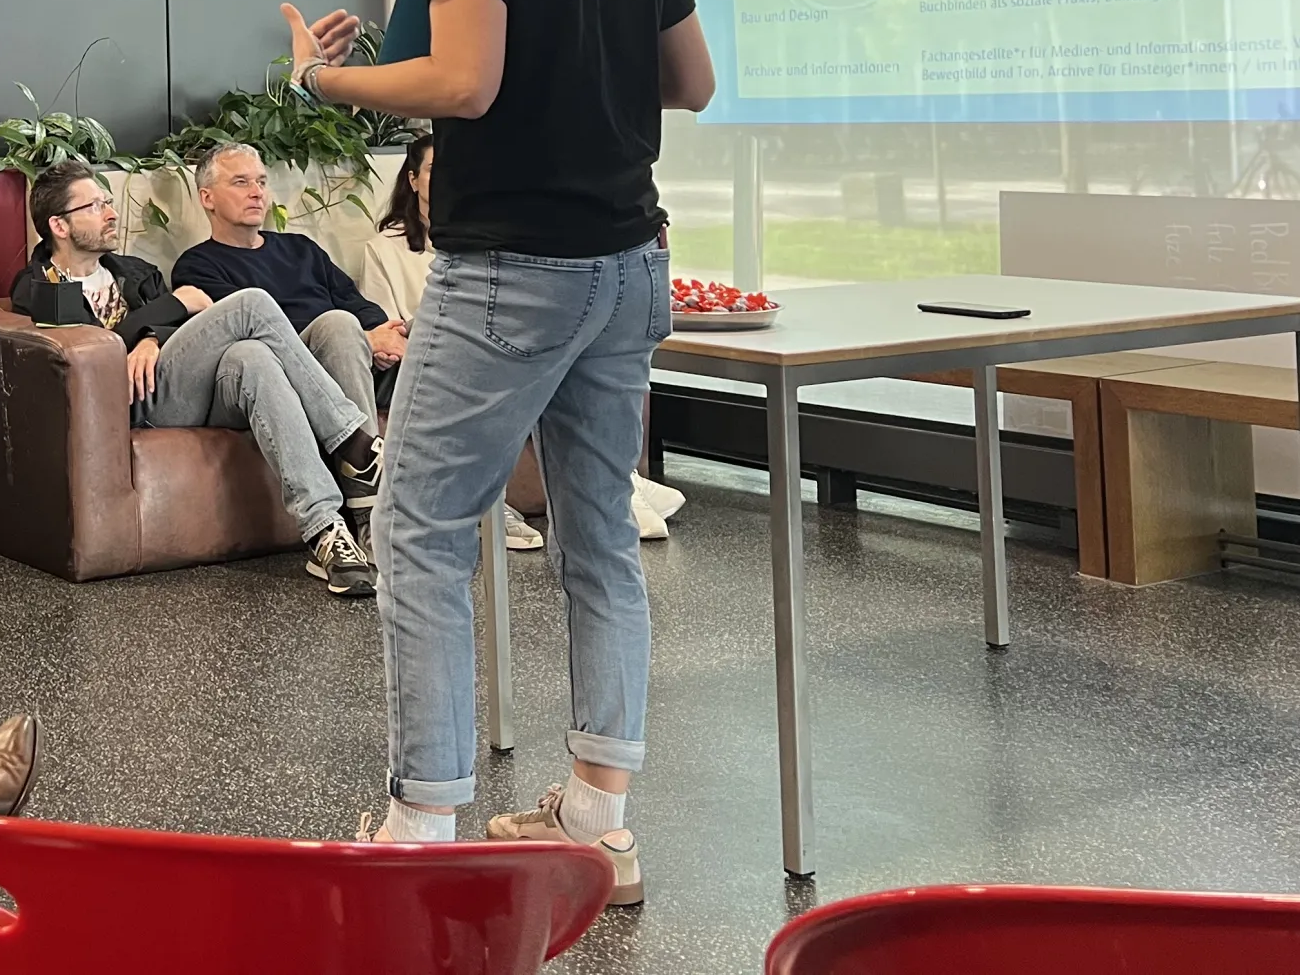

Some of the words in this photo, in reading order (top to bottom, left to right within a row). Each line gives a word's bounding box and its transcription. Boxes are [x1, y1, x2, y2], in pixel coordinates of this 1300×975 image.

[919, 0, 987, 13] Buchbinden
[741, 11, 761, 24] Bau
[764, 10, 786, 23] und
[789, 8, 829, 23] Design
[1030, 46, 1047, 58] für
[1107, 42, 1131, 56] und
[744, 64, 783, 77] Archive
[787, 63, 808, 75] und
[811, 60, 900, 75] Informationen
[921, 67, 987, 82] Bewegtbild
[991, 67, 1013, 79] und
[1048, 63, 1094, 76] Archive
[1100, 63, 1116, 75] für
